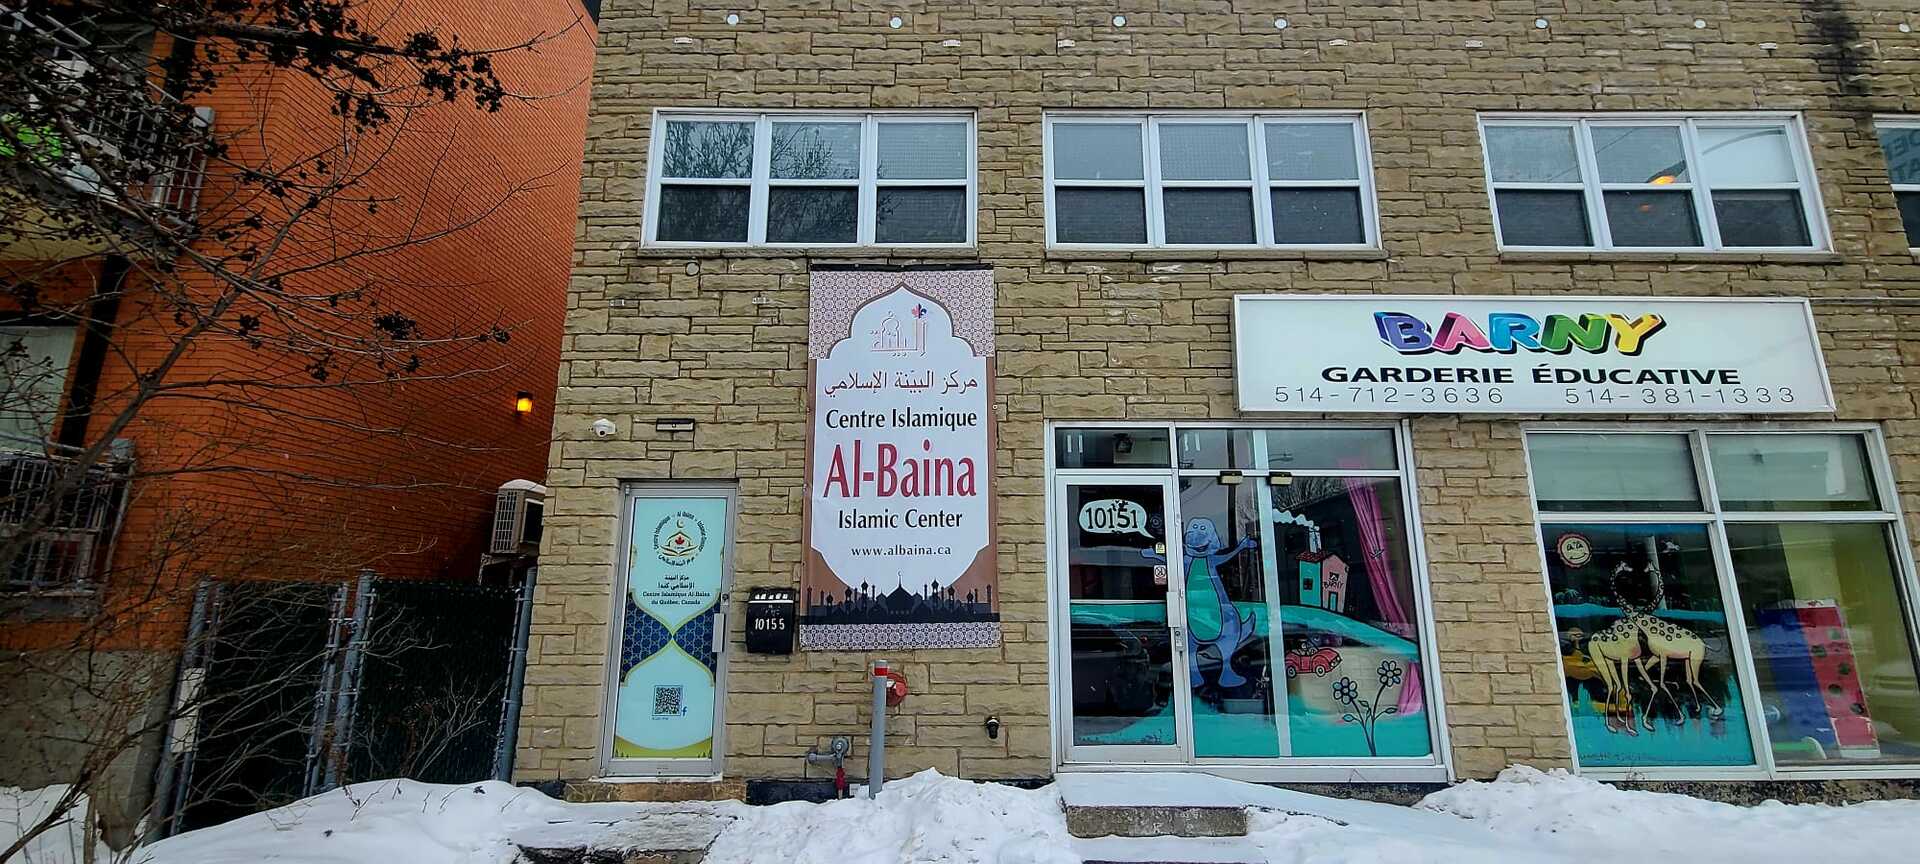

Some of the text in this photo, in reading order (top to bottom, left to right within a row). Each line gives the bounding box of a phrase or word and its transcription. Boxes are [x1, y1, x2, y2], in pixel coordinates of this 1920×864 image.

[1373, 311, 1666, 357] BARNY
[940, 369, 978, 394] مركز
[1321, 362, 1741, 385] GARDERIE ÉDUCATIVE
[1274, 386, 1795, 404] 514-712-3636 514-381-1333
[826, 407, 977, 432] Centre Islamique
[823, 439, 977, 498] Al-Baina
[839, 509, 962, 530] Islamic Center
[1086, 507, 1138, 529] 10151
[851, 545, 952, 558] www.albaina.ca
[755, 618, 785, 630] 10155
